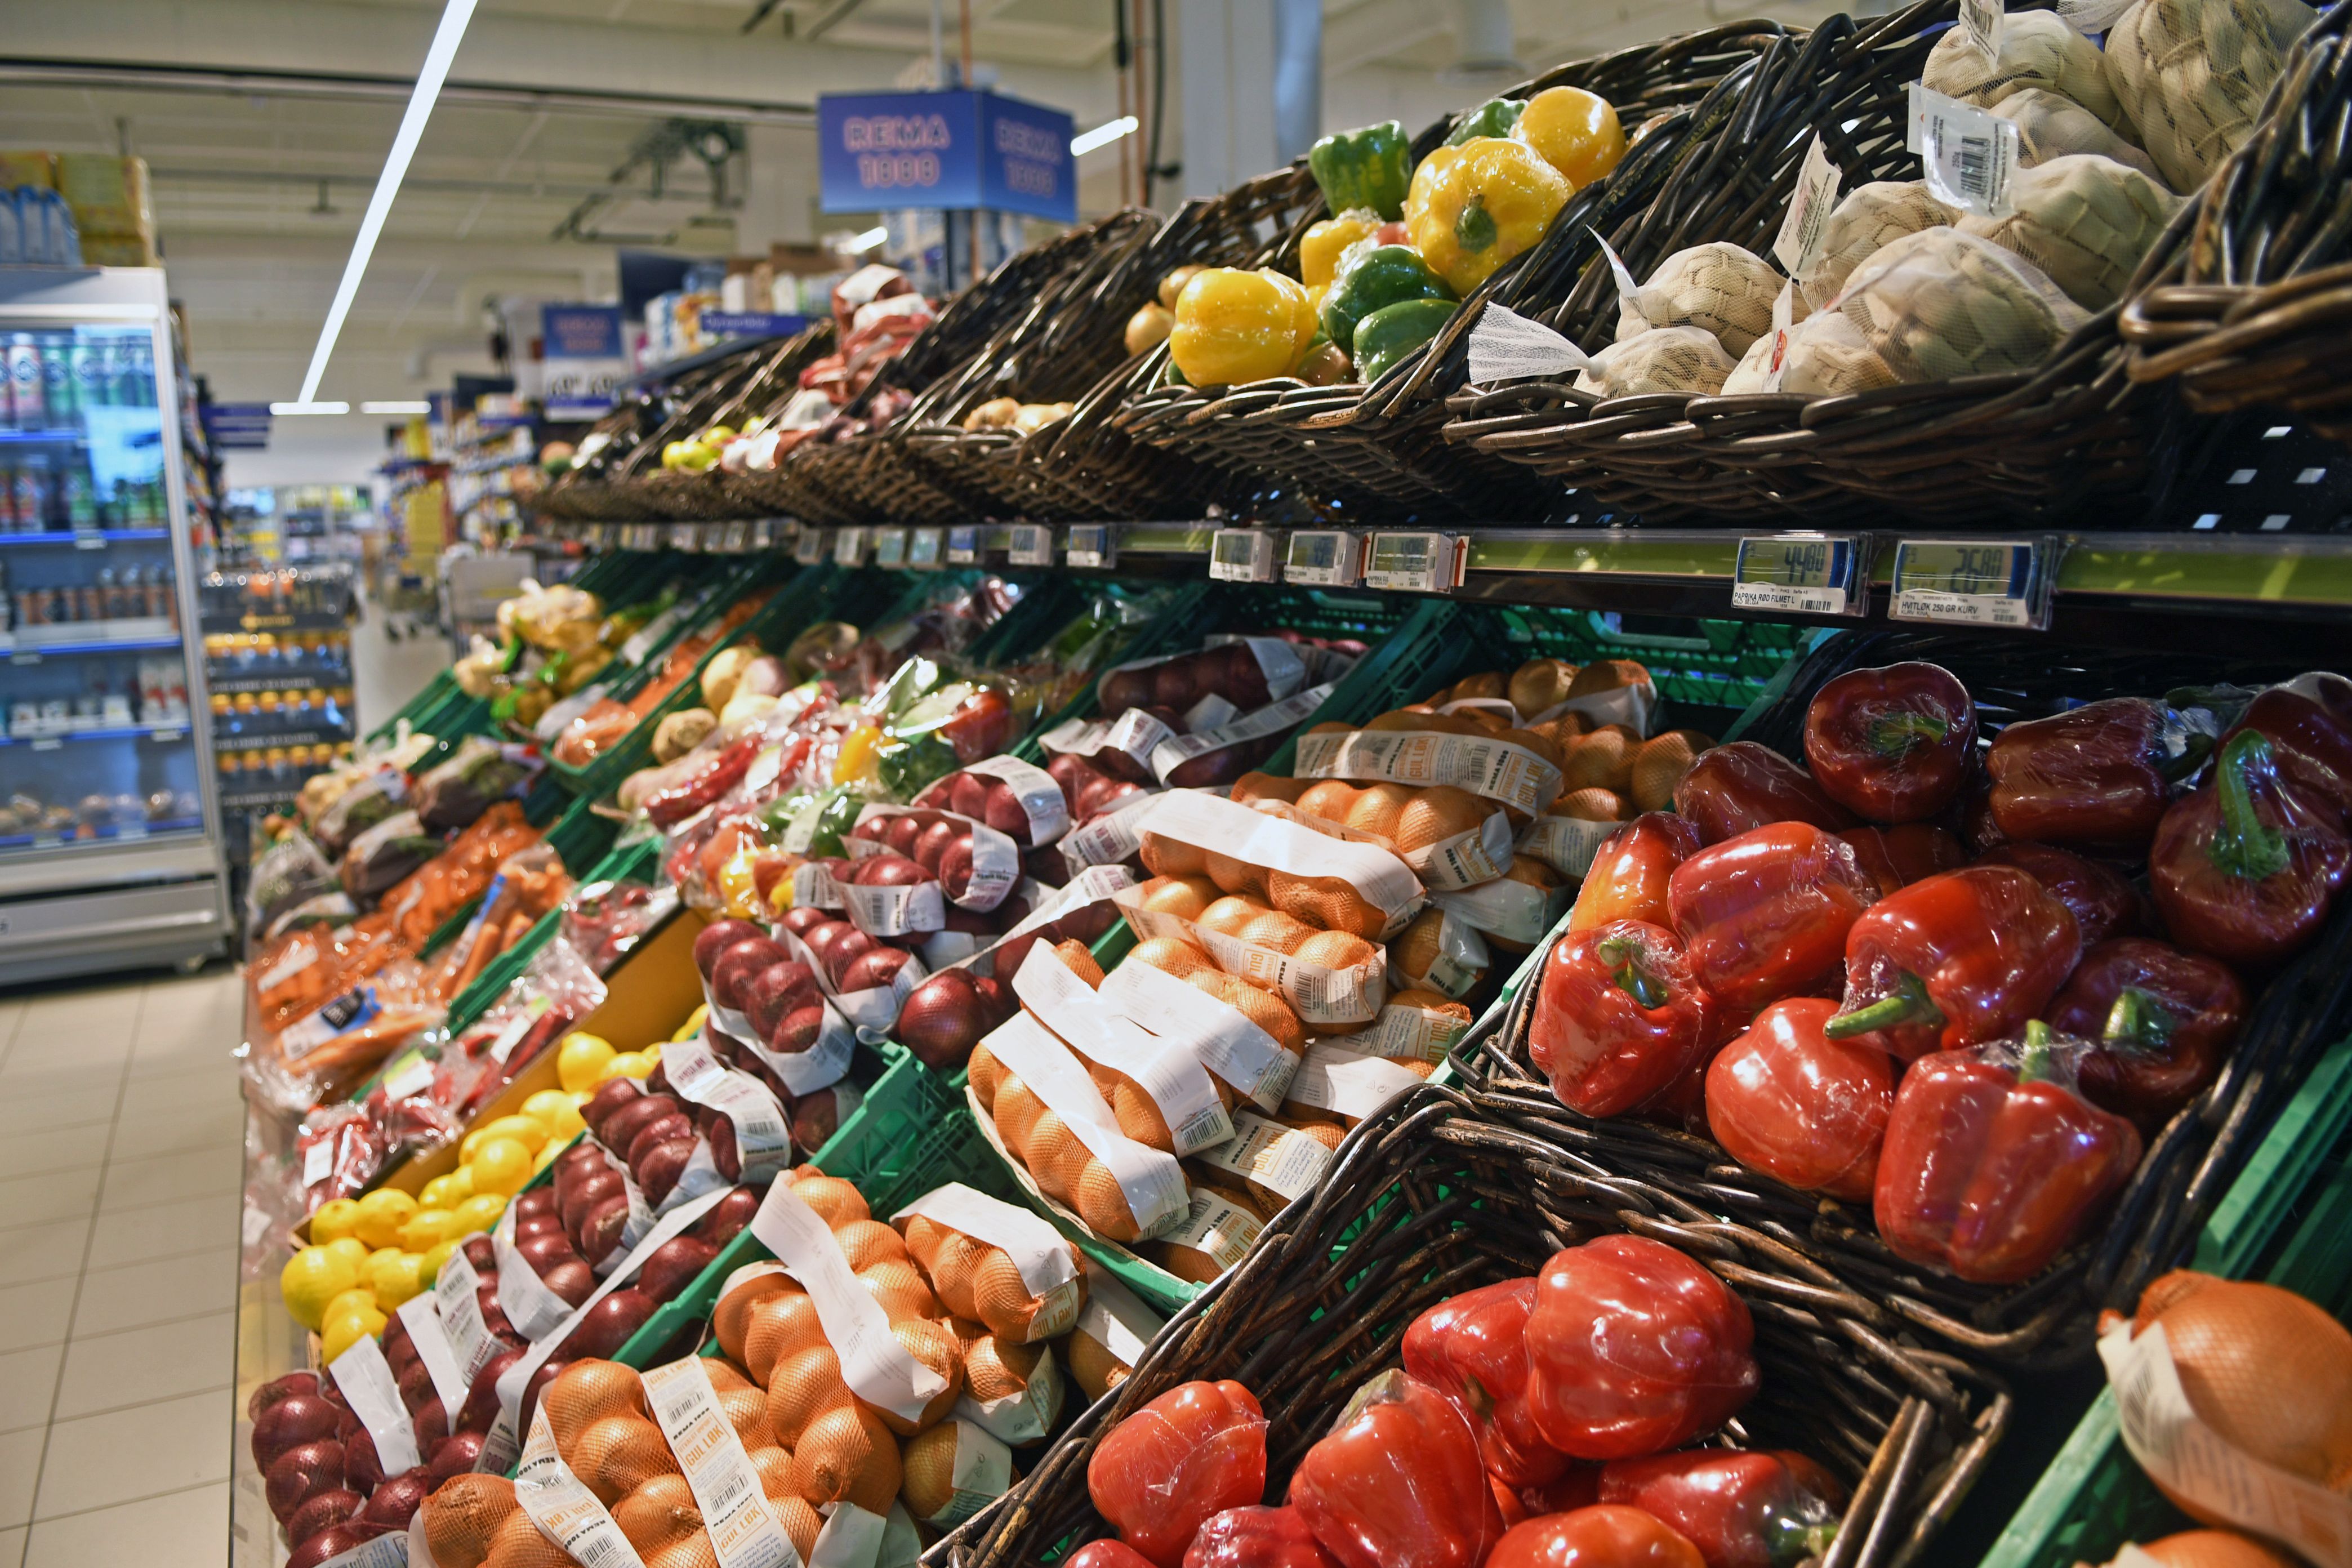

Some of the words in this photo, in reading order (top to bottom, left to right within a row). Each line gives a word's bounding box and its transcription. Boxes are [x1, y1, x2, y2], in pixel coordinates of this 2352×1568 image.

[844, 114, 951, 152] REMA
[1952, 152, 1961, 168] 250g
[858, 152, 939, 189] 1000
[1735, 592, 1757, 602] PAPRIKA
[1758, 593, 1770, 602] RØD
[1771, 594, 1790, 603] FILMET
[1901, 601, 1930, 611] HVITLØK
[1932, 603, 1945, 612] 250
[1946, 604, 1957, 613] GR
[1958, 604, 1979, 614] KURV
[1413, 738, 1429, 756] LØK
[1410, 759, 1423, 777] GUL
[1489, 764, 1501, 790] REMA
[1496, 750, 1509, 766] 1000
[1524, 760, 1547, 781] LØK
[1517, 782, 1536, 805] GUL
[1453, 865, 1468, 884] REMA
[1249, 953, 1264, 974] GUL
[1278, 961, 1287, 986] REMA
[1429, 972, 1446, 990] REMA
[1429, 1022, 1451, 1042] GUL
[1231, 1142, 1248, 1165] REMA
[1245, 1125, 1259, 1143] 1000
[1241, 1144, 1258, 1167] UTVALGT
[1255, 1128, 1268, 1146] IMPORT
[1252, 1151, 1273, 1170] GUL
[1263, 1130, 1285, 1151] LØK
[1214, 1209, 1231, 1223] 1000
[1033, 1318, 1050, 1339] GUL
[528, 1423, 545, 1442] GU
[673, 1421, 693, 1440] REMA
[694, 1407, 710, 1422] 1000
[678, 1432, 698, 1453] UTVALGT
[685, 1444, 707, 1467] GUL
[702, 1425, 724, 1449] LØK
[532, 1456, 556, 1466] REMA
[516, 1465, 532, 1478] 1000
[571, 1502, 594, 1516] GUL
[714, 1509, 736, 1527] REMA
[737, 1493, 753, 1508] 1000
[546, 1510, 571, 1530] LØK
[580, 1519, 607, 1535] REMA
[716, 1517, 737, 1538] UTVALGT
[720, 1528, 739, 1549] GUL
[739, 1506, 761, 1530] LØK
[564, 1533, 581, 1551] 1000
[728, 1554, 741, 1566] Denne
[742, 1547, 754, 1556] varen
[755, 1533, 773, 1547] kommer
[745, 1548, 759, 1561] landet
[755, 1547, 774, 1561] kvalitet
